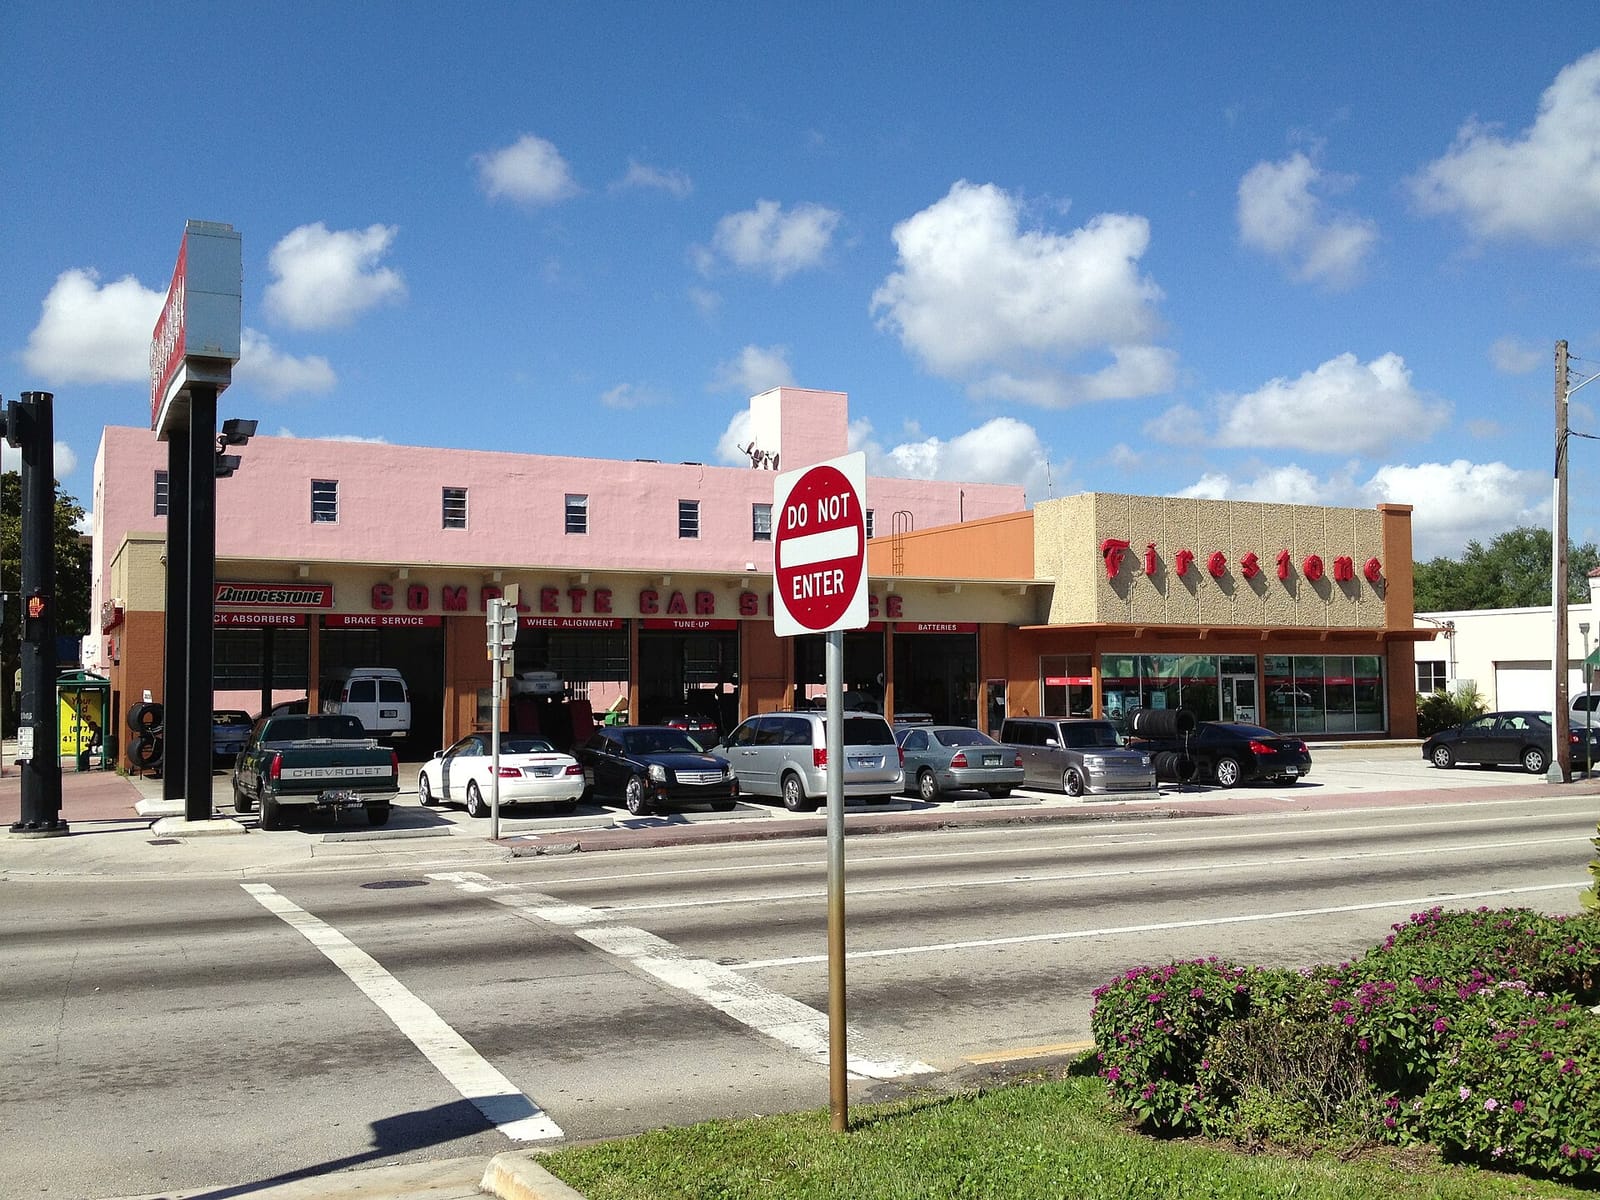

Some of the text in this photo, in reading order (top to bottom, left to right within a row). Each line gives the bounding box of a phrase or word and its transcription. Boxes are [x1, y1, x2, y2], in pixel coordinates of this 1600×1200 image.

[787, 492, 850, 530] DO NOT
[1101, 538, 1382, 582] Firestone
[793, 569, 844, 600] ENTER
[216, 585, 323, 604] BRIDGESTONE
[639, 590, 715, 615] CAR
[231, 615, 296, 624] ABSORBERS
[344, 616, 424, 625] BRAKE SERVICE
[526, 618, 615, 627] WHEEL ALIGNMENT
[673, 620, 710, 628] TUNE-UP
[918, 623, 957, 631] BATTERIES
[292, 767, 381, 778] CHEVROLET
